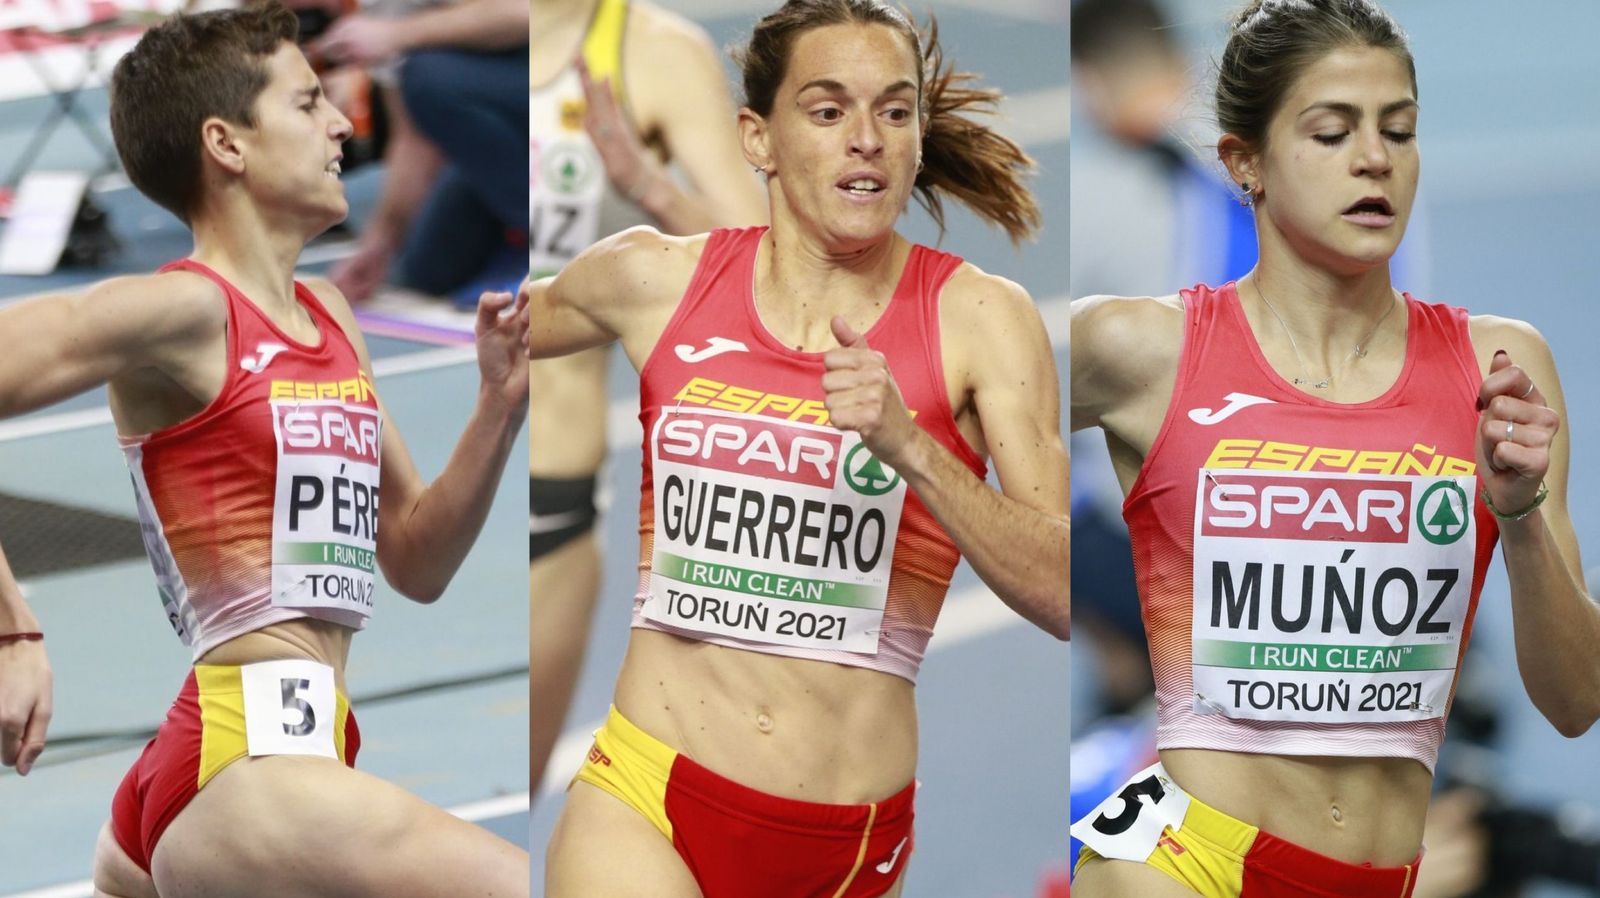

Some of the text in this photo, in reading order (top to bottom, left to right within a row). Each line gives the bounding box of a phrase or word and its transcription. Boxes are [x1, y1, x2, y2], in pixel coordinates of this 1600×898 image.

[284, 412, 377, 458] SPAR
[662, 419, 834, 480] SPAR
[662, 474, 886, 574] GUERRERO
[1209, 484, 1404, 534] SPAR
[323, 544, 328, 562] I
[334, 545, 356, 566] RUN
[682, 562, 689, 579] I
[693, 564, 742, 589] RUN
[666, 589, 847, 641] TORUŃ 2021
[1250, 645, 1256, 666] I
[1263, 646, 1318, 668] RUN
[280, 678, 316, 737] 5
[1227, 678, 1423, 712] TORUŃ 2021
[1092, 774, 1165, 835] 5
